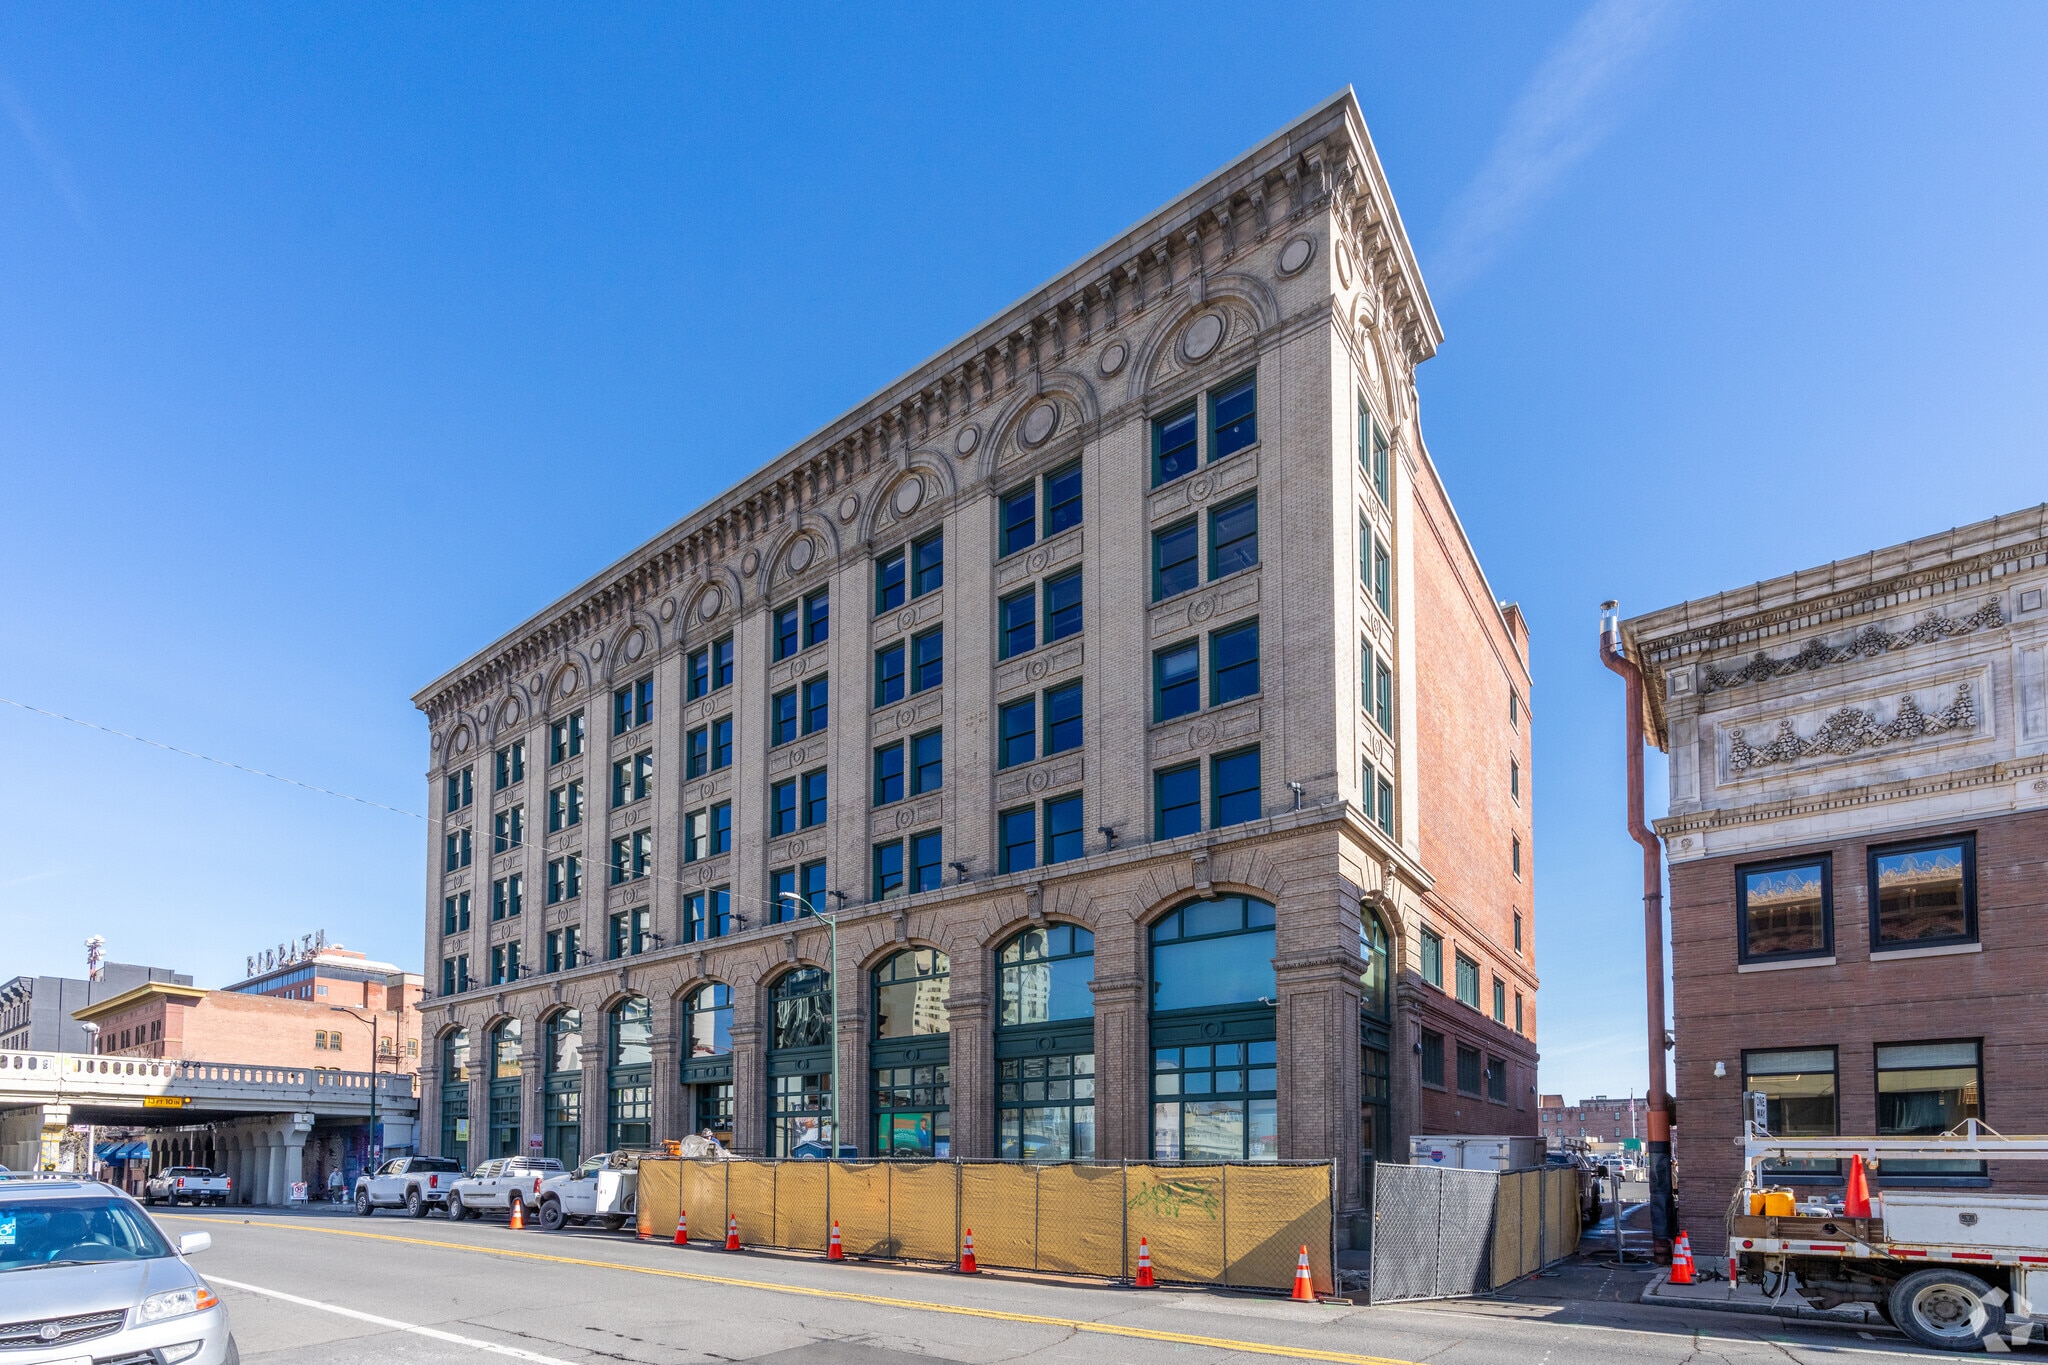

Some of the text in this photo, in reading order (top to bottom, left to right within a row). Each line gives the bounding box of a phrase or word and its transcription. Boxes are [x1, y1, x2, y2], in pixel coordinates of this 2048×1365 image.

[246, 928, 325, 978] RIDPATH
[1756, 1095, 1765, 1107] ONE
[1756, 1108, 1766, 1119] WAY
